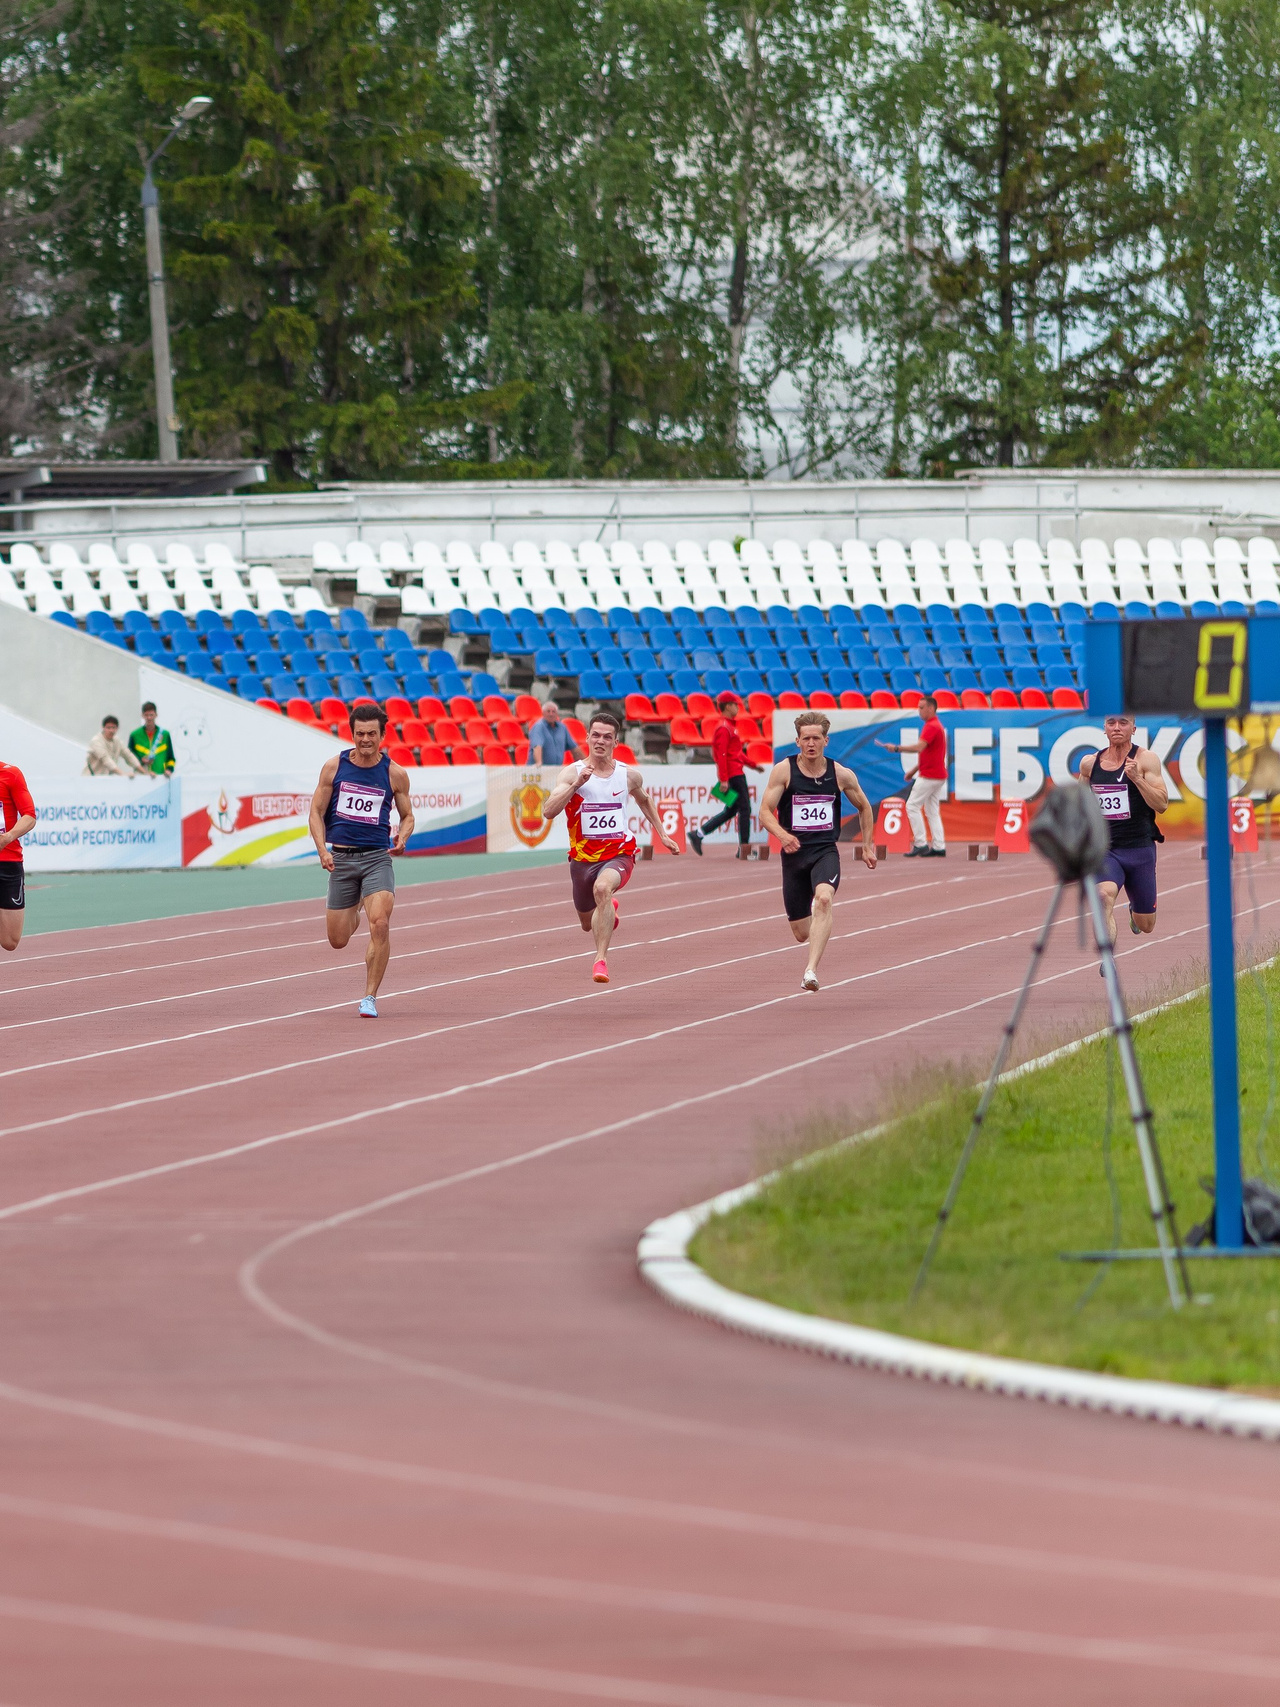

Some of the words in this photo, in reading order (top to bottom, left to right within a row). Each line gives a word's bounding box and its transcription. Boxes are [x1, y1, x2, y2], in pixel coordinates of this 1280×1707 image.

[1193, 621, 1248, 710] 0
[110, 803, 168, 820] КУЛЬТУРЫ
[253, 796, 294, 817] ЦЕНТР
[346, 796, 374, 813] 108
[410, 794, 462, 810] ОТОВКИ
[1098, 797, 1121, 810] 233
[589, 815, 617, 829] 266
[662, 810, 679, 836] 8
[800, 807, 827, 821] 346
[883, 809, 902, 835] 6
[1003, 808, 1023, 834] 5
[1232, 808, 1251, 834] 3
[23, 827, 79, 847] ВАШСКОЙ
[81, 829, 156, 846] РЕСПУБЛИКИ
